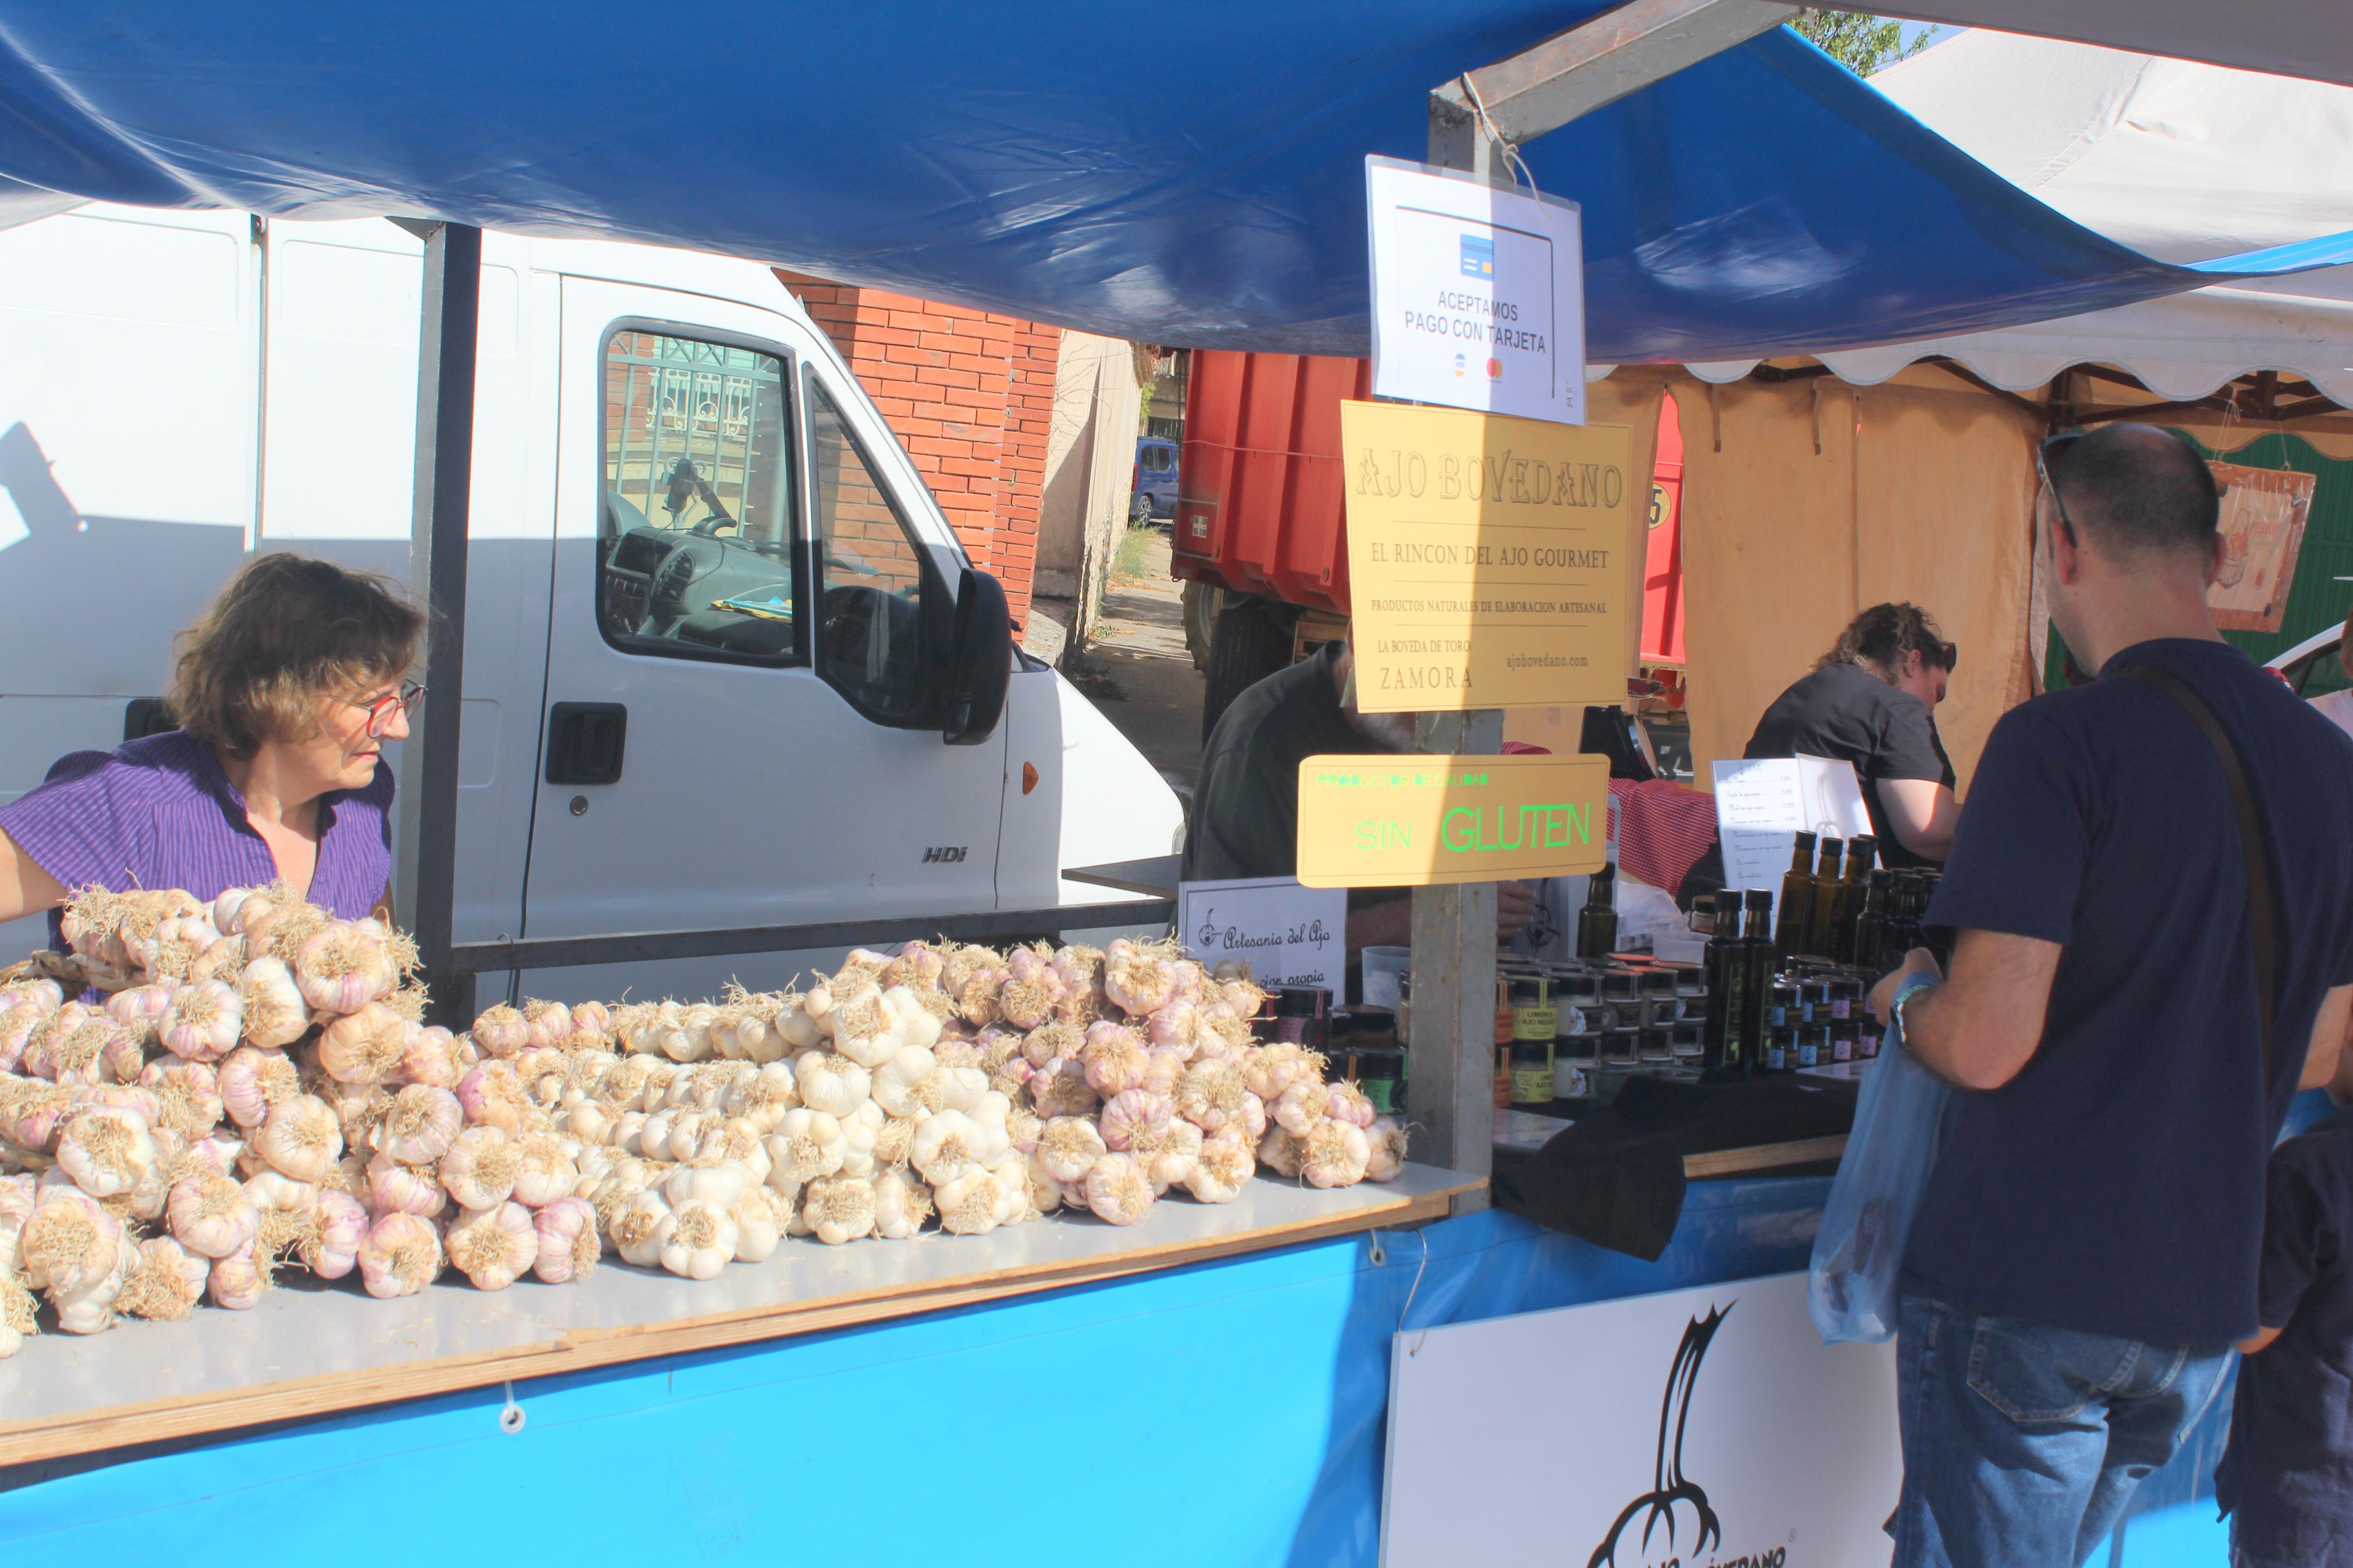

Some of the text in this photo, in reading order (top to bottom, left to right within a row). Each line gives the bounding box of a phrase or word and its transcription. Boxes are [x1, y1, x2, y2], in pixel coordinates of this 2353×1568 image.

[1438, 290, 1518, 322] ACEPTAMOS
[1405, 311, 1546, 354] PAGO CON TARJETA
[1355, 448, 1623, 509] AJO BOVEDANO
[1371, 543, 1610, 569] EL RINCON DEL AJO GOURMET
[1372, 600, 1607, 614] PRODUCTOS NATURALES DE ELABORACION ARTESANAL
[1378, 640, 1471, 653] LA BOVEDA DE TORO
[1507, 653, 1589, 671] ajobovedano.com
[1381, 667, 1474, 690] ZAMORA
[1317, 774, 1488, 787] PRODUCTOS DE CALIDAD
[1355, 803, 1591, 852] SIN GLUTEN
[922, 847, 968, 863] HDi
[1223, 919, 1330, 951] Artesania del Ajo
